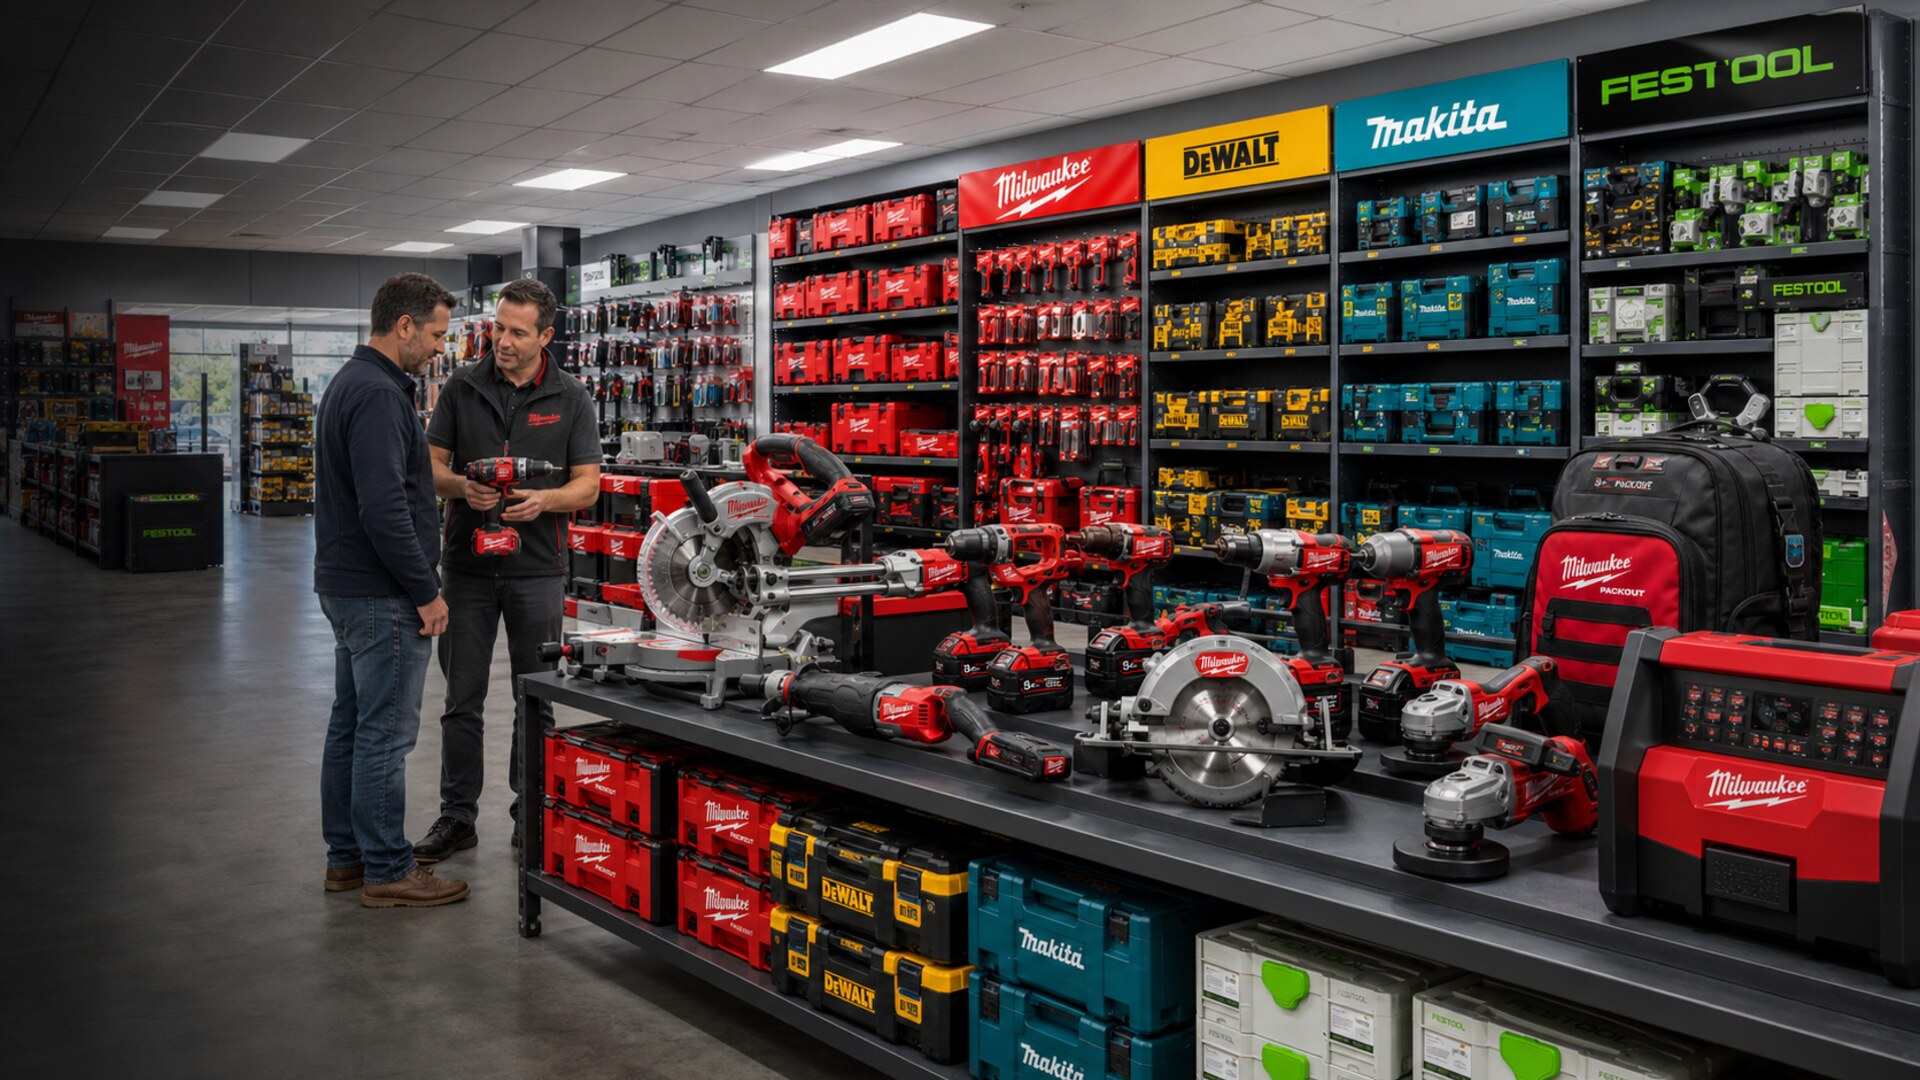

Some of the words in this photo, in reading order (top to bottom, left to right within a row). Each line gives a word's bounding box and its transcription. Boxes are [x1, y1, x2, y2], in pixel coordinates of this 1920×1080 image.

[993, 157, 1091, 209] Milwaukee
[1773, 281, 1847, 296] FESTOOL
[1560, 553, 1632, 581] Milwaukee
[1600, 586, 1645, 597] PACKOUT
[1705, 769, 1809, 797] Milwaukee
[704, 800, 749, 822] Milwaukee
[704, 886, 749, 911] Milwaukee
